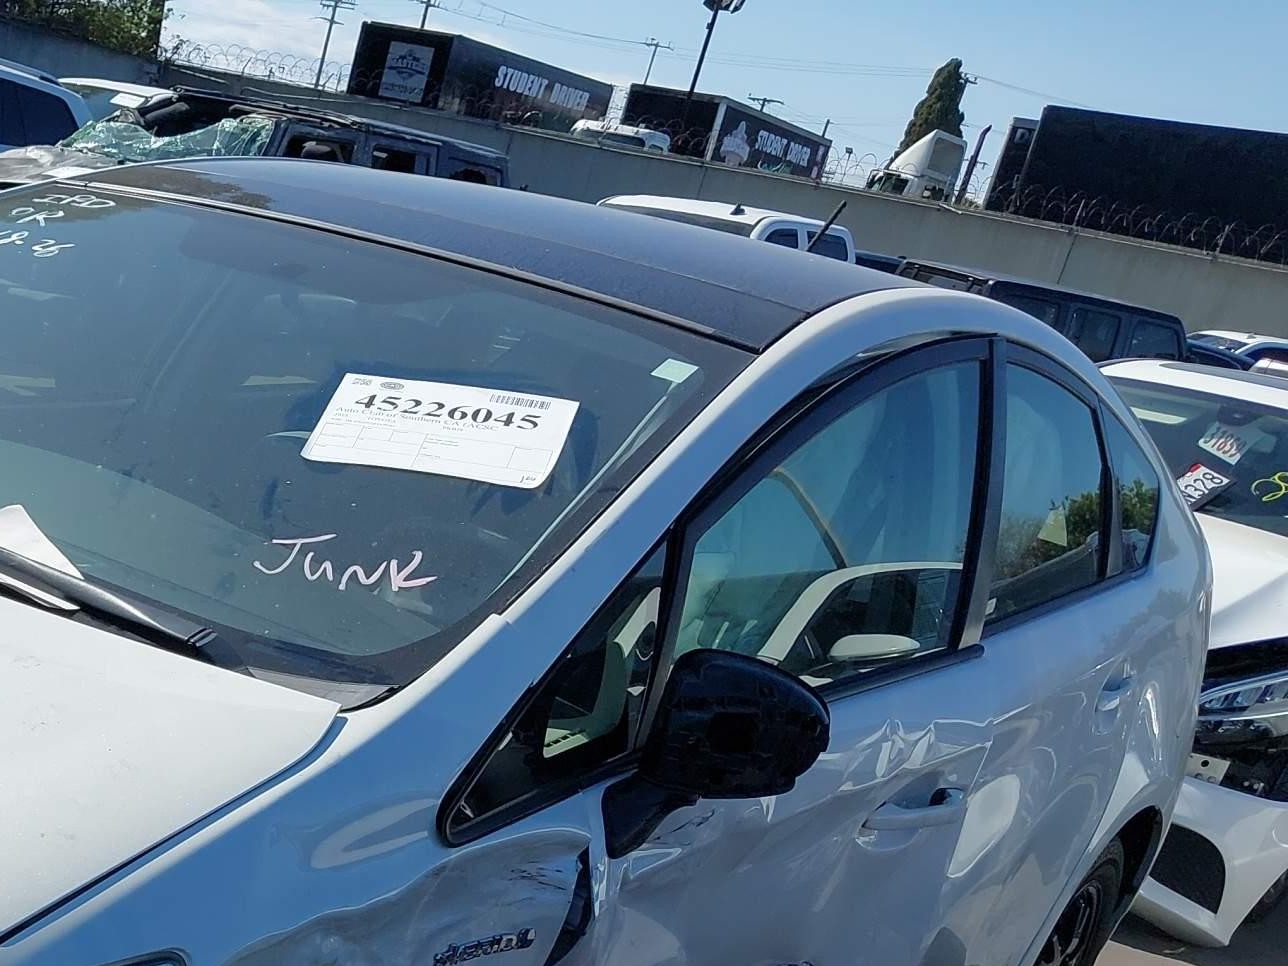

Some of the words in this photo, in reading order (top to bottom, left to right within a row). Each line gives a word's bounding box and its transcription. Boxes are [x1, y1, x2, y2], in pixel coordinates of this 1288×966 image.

[494, 65, 548, 99] STUDENT
[549, 82, 590, 111] DRIVER
[755, 129, 788, 158] STUDENT
[786, 141, 811, 167] DRIVER
[355, 393, 542, 430] 45226045
